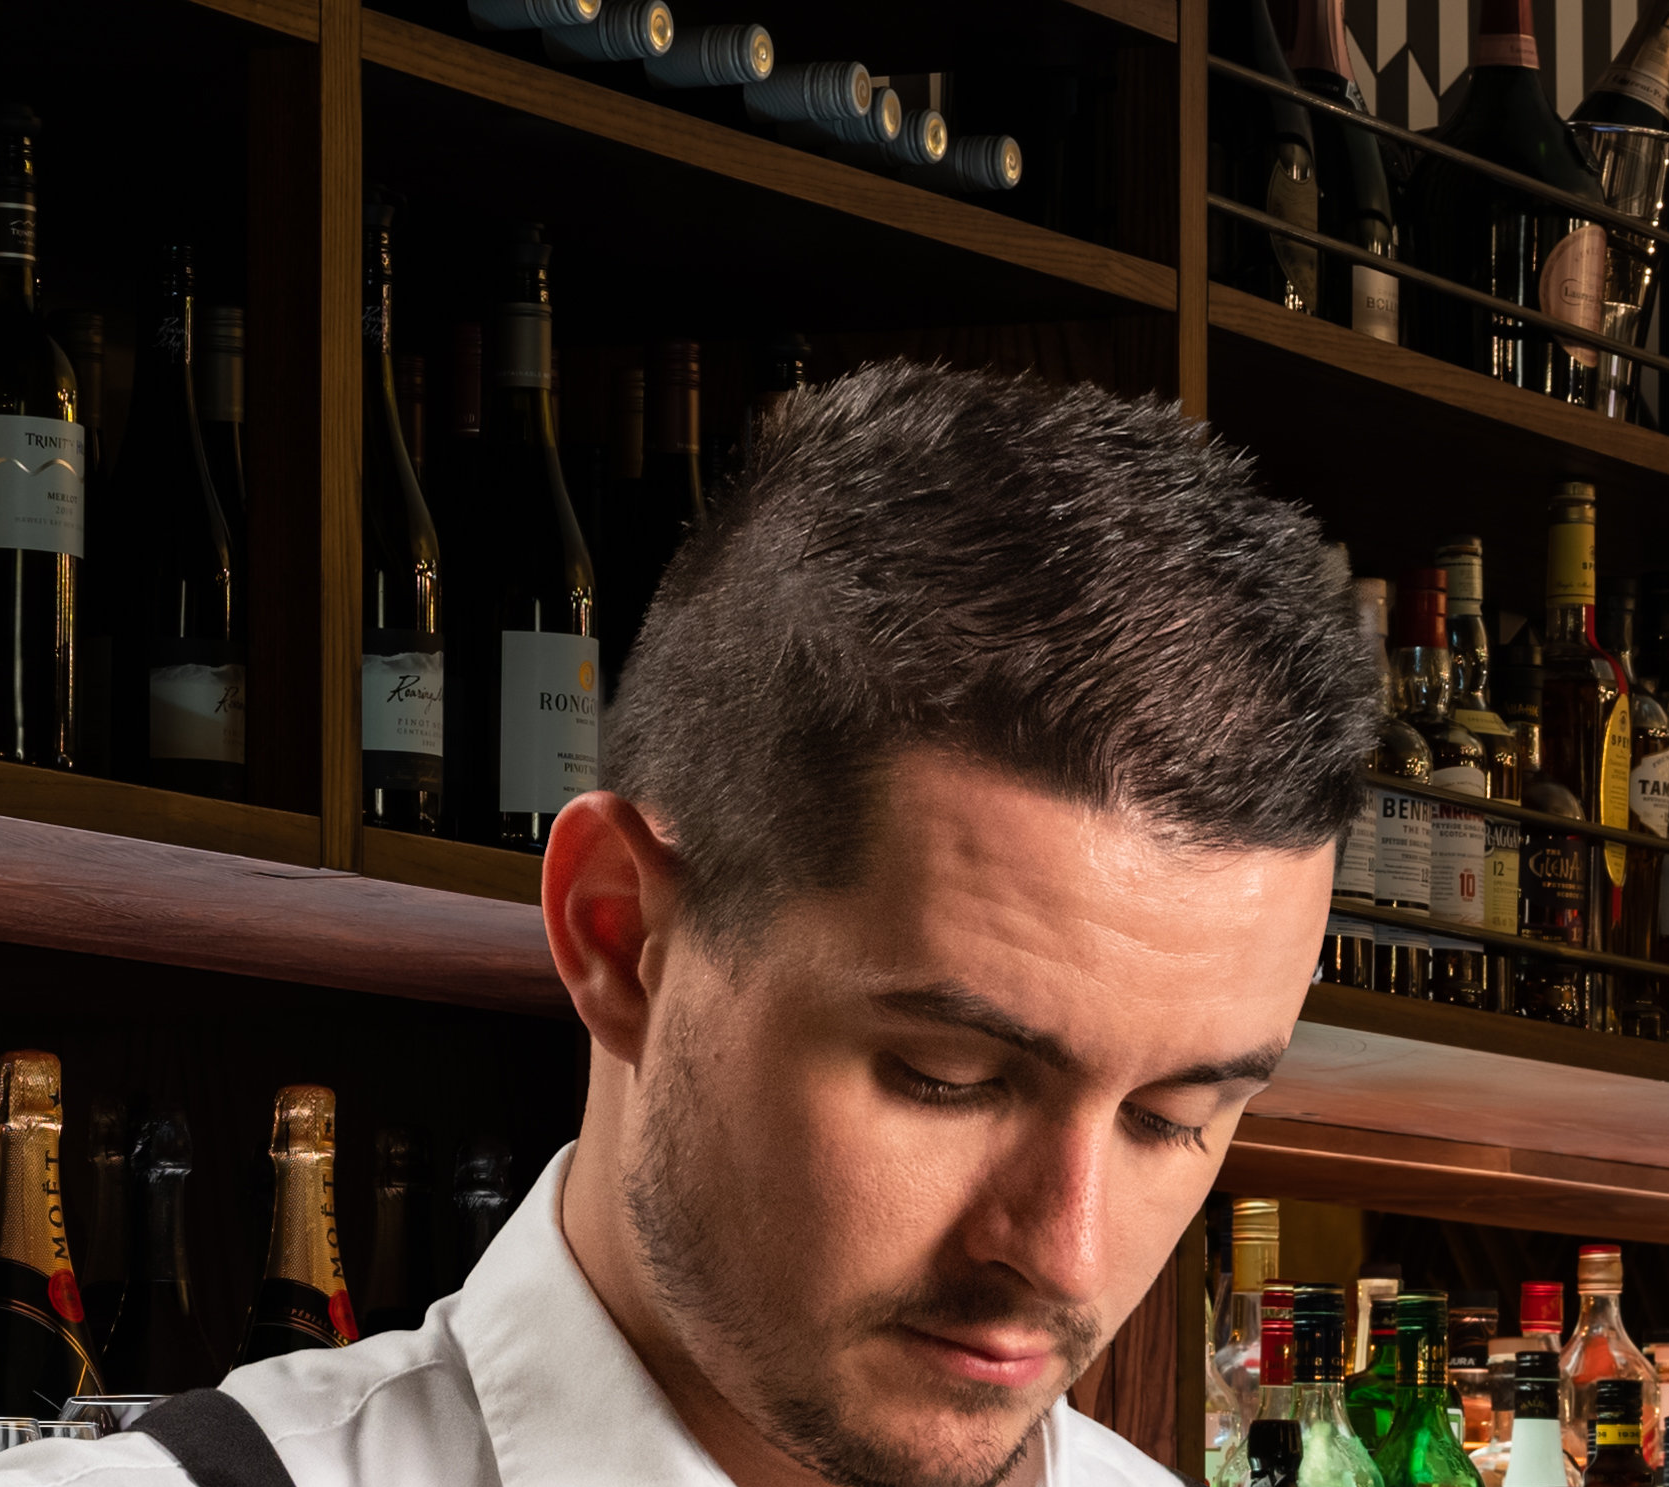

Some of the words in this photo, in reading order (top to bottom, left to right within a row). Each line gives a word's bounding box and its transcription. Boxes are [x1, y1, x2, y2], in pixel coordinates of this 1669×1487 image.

[1459, 872, 1476, 898] 10
[1492, 860, 1505, 877] 12
[43, 1150, 70, 1261] MOËT
[320, 1173, 345, 1280] MOËT
